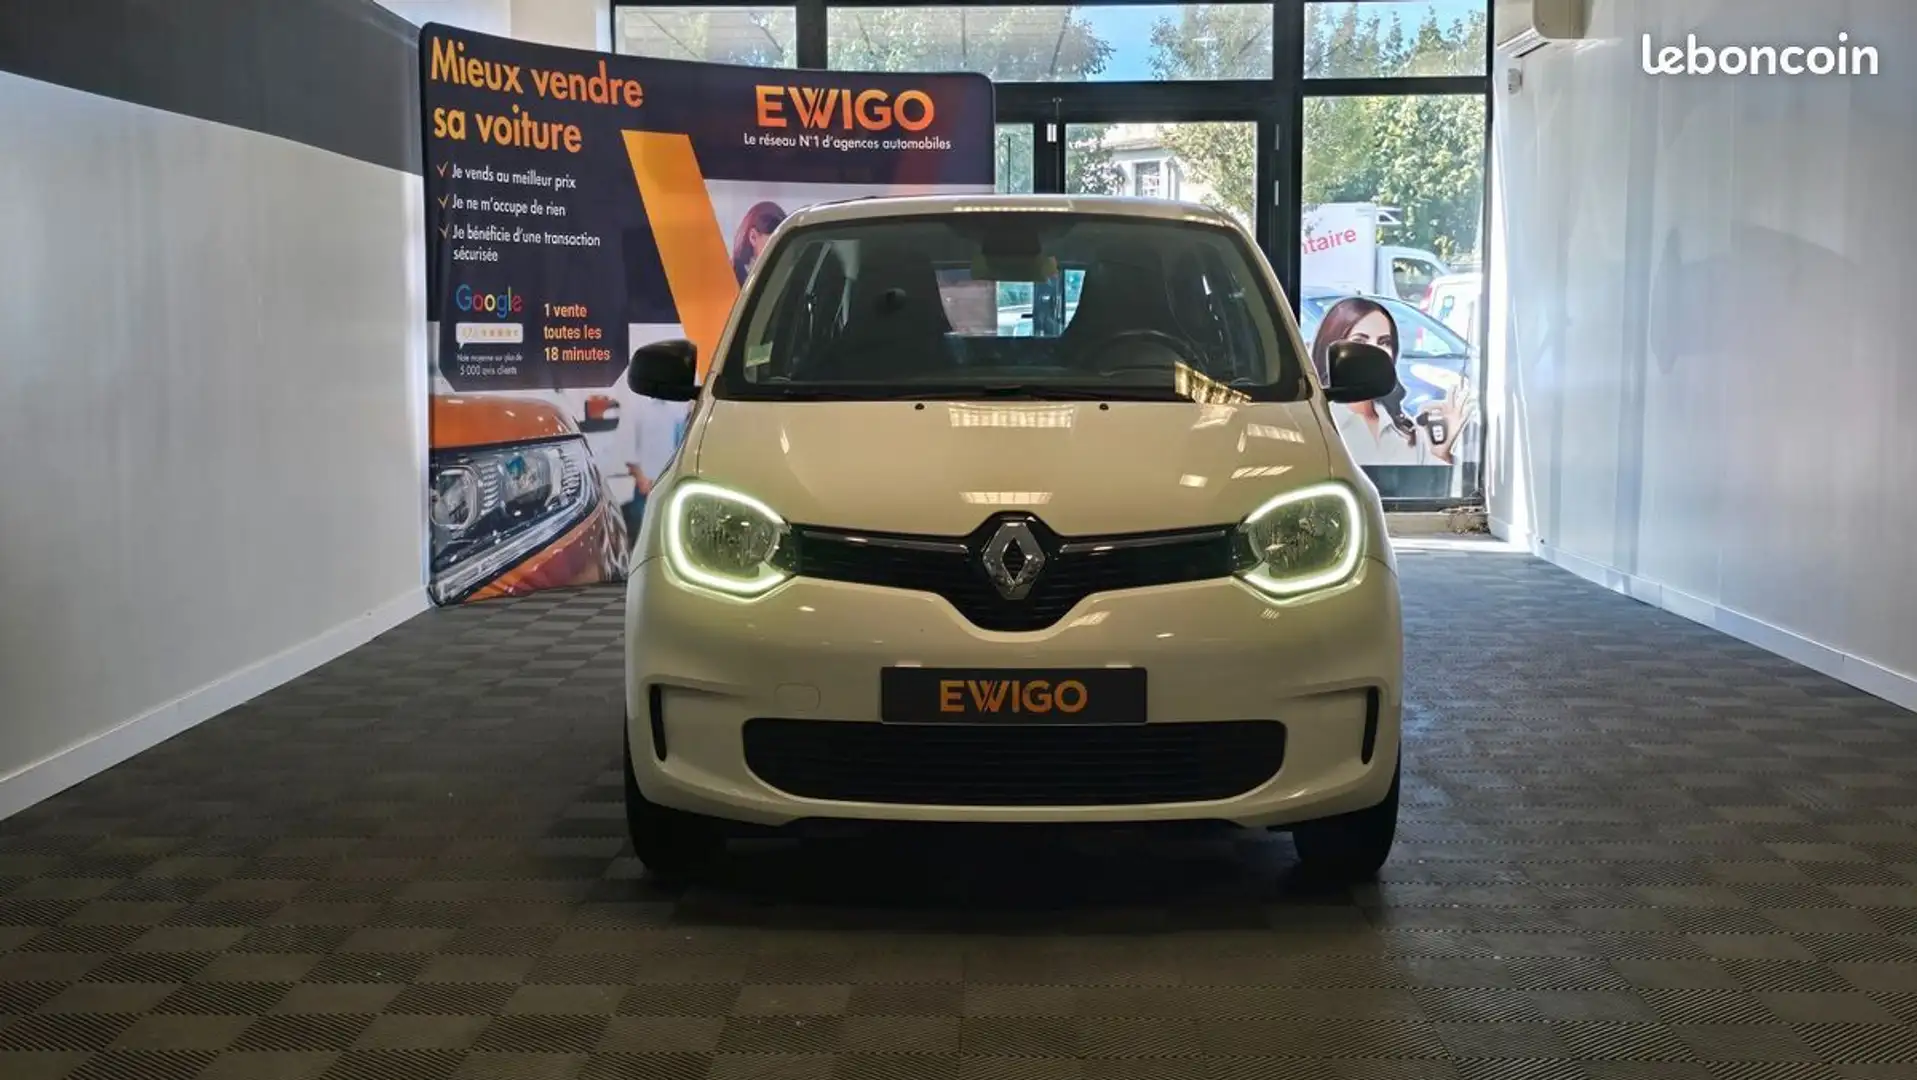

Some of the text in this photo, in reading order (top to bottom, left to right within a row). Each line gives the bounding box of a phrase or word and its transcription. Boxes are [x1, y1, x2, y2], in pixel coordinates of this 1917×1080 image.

[430, 36, 644, 108] Mieux vendre
[755, 84, 935, 131] EWIGO
[433, 103, 582, 153] sa voiture
[744, 133, 755, 145] Le
[758, 133, 796, 147] réseau
[822, 135, 879, 151] d'agences
[882, 136, 951, 150] automobiles
[452, 164, 577, 191] Je vends au meilleur prix
[452, 193, 566, 217] Je ne m'occupe de rien
[452, 223, 601, 247] Je bénéficie d'une transaction
[453, 246, 499, 262] sécurisée
[456, 283, 523, 318] Google
[544, 303, 587, 318] 1 vente
[543, 325, 602, 339] toutes les
[544, 347, 611, 361] 18 minutes
[939, 679, 1089, 714] EWIGO
